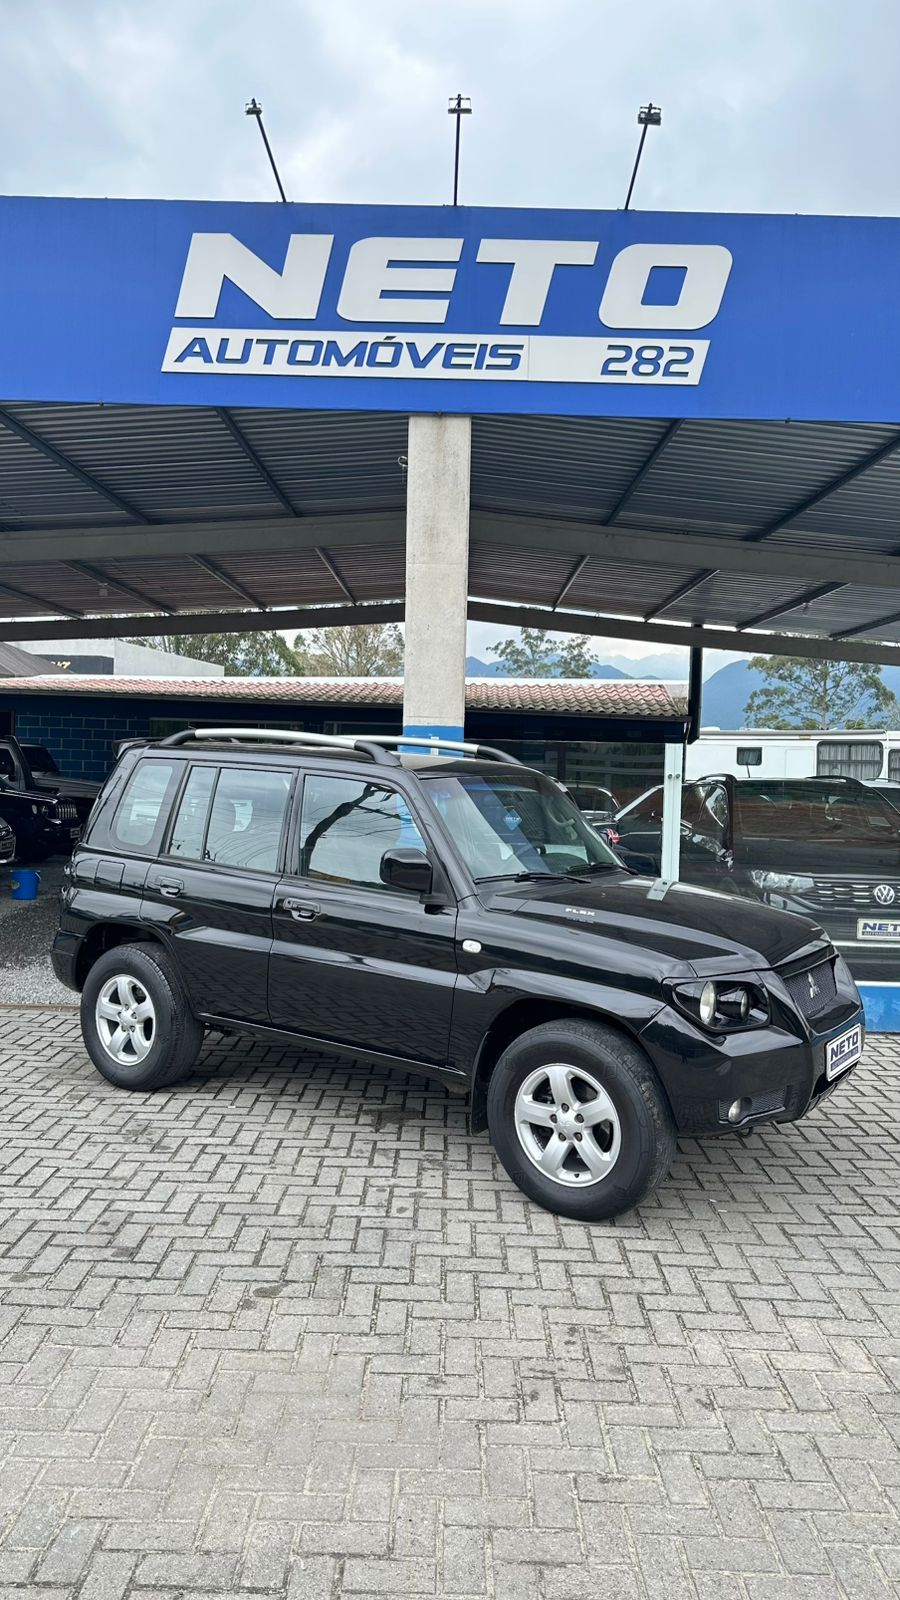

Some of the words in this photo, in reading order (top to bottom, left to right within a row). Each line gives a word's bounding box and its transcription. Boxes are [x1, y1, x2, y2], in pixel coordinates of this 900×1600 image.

[174, 232, 733, 330] NETO
[174, 335, 524, 371] AUTOMÓVEIS
[600, 344, 695, 378] 282
[830, 1031, 859, 1062] NETO
